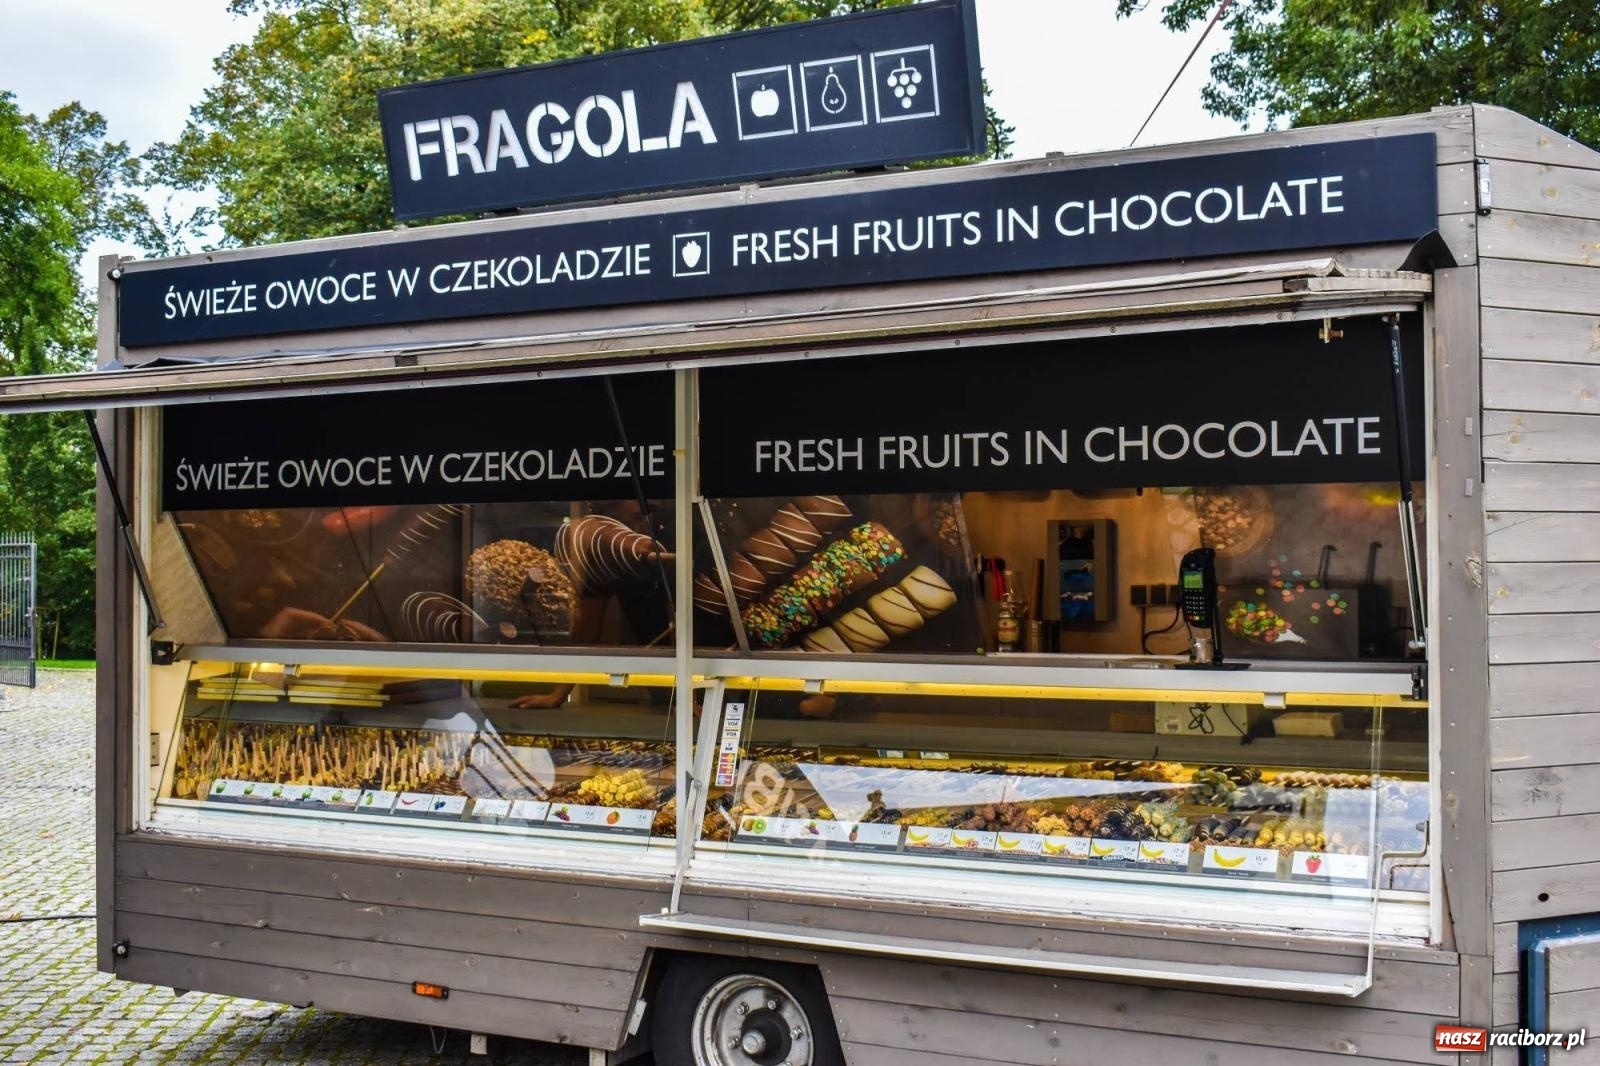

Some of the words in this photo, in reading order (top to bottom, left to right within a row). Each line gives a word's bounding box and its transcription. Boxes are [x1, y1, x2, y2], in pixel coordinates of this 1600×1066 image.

[403, 80, 718, 182] FRAGOLA
[732, 224, 838, 267] FRESH
[853, 210, 982, 256] FRUITS
[996, 205, 1039, 243] IN
[1054, 175, 1345, 237] CHOCOLATE
[164, 280, 258, 320] ŚWIEŻE
[265, 271, 377, 310] OWOCE
[387, 266, 421, 298] W
[429, 243, 651, 294] CZEKOLADZIE
[176, 456, 269, 491] ŚWIEŻE
[278, 456, 392, 488] OWOCE
[399, 454, 434, 484] W
[439, 444, 665, 483] CZEKOLADZIE
[756, 437, 863, 473] FRESH
[879, 431, 1010, 470] FRUITS
[1025, 429, 1068, 465] IN
[1084, 416, 1381, 463] CHOCOLATE
